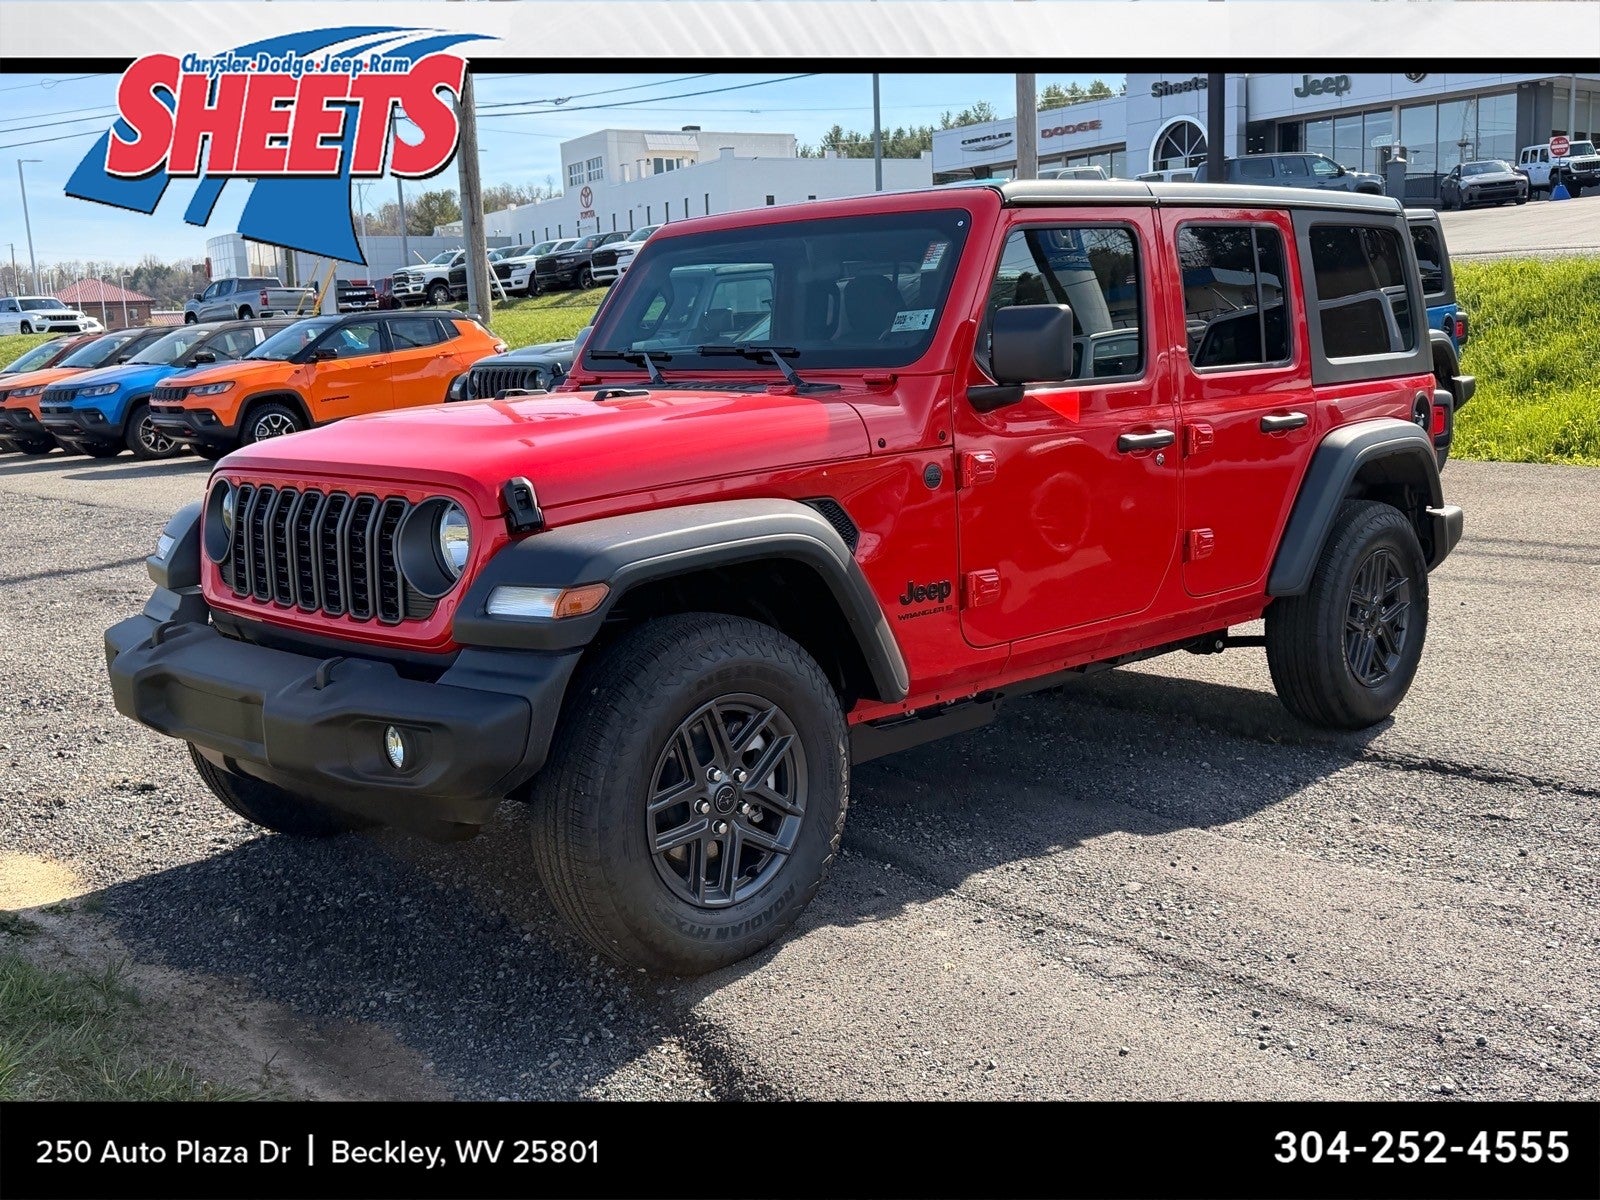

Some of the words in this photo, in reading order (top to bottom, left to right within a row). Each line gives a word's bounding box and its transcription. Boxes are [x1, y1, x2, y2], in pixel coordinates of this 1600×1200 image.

[1151, 76, 1208, 97] Sheets
[1294, 74, 1350, 97] Jeep
[961, 132, 1012, 145] CHRYSLER
[1041, 119, 1103, 139] DODGE
[899, 579, 951, 605] Jeep
[897, 606, 945, 620] WRANGLER
[715, 880, 801, 939] ROADIAN
